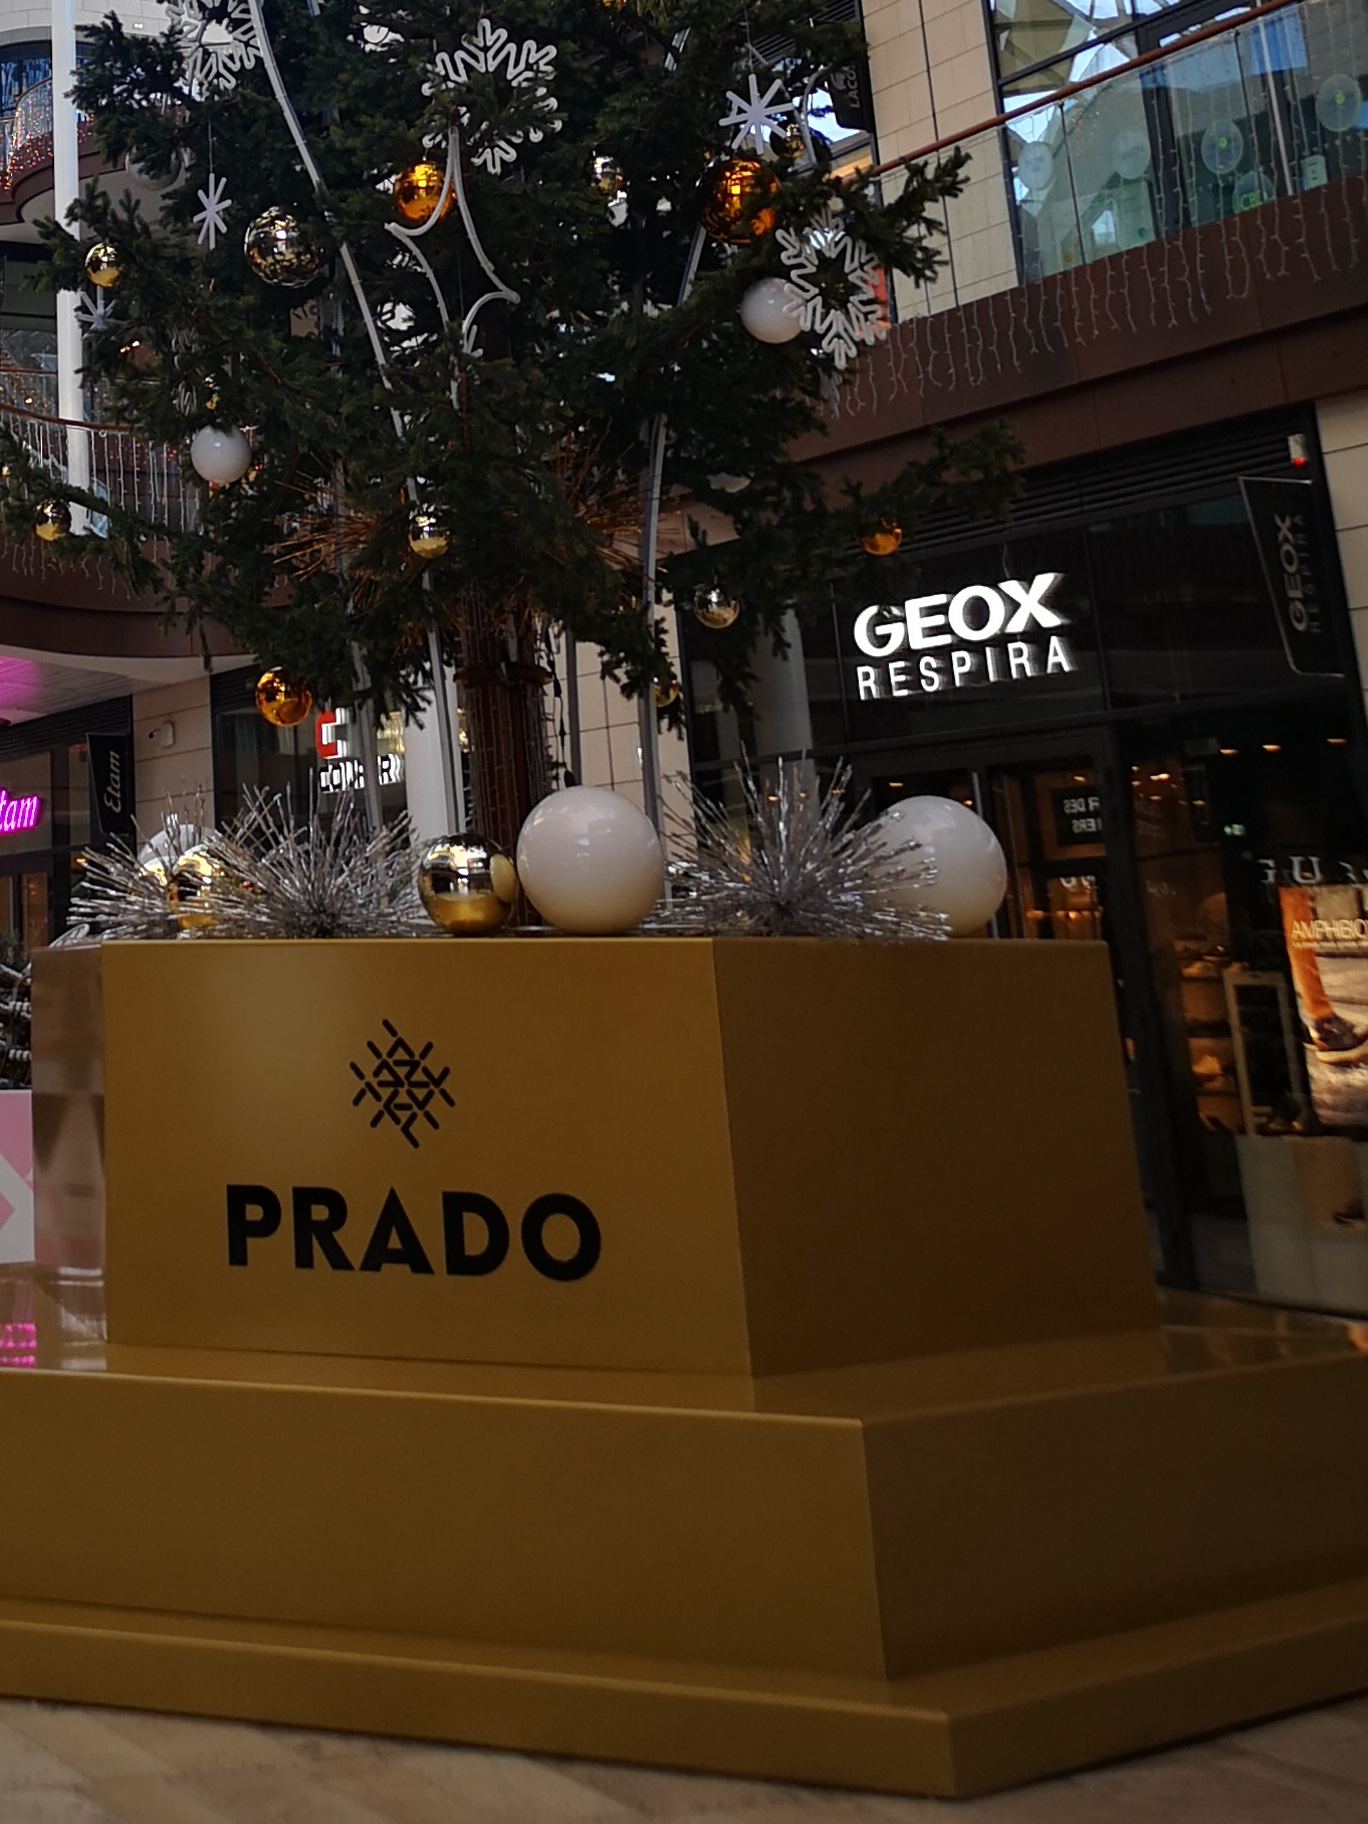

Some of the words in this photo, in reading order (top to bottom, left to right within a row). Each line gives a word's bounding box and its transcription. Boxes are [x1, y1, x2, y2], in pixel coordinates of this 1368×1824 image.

[844, 65, 861, 109] LACO
[1273, 513, 1309, 633] GEOX
[853, 571, 1069, 657] GEOX
[856, 635, 1075, 701] RESPIRA
[103, 750, 122, 814] Etam
[1291, 918, 1368, 940] AMPHIBIO
[226, 1184, 601, 1281] PRADO
